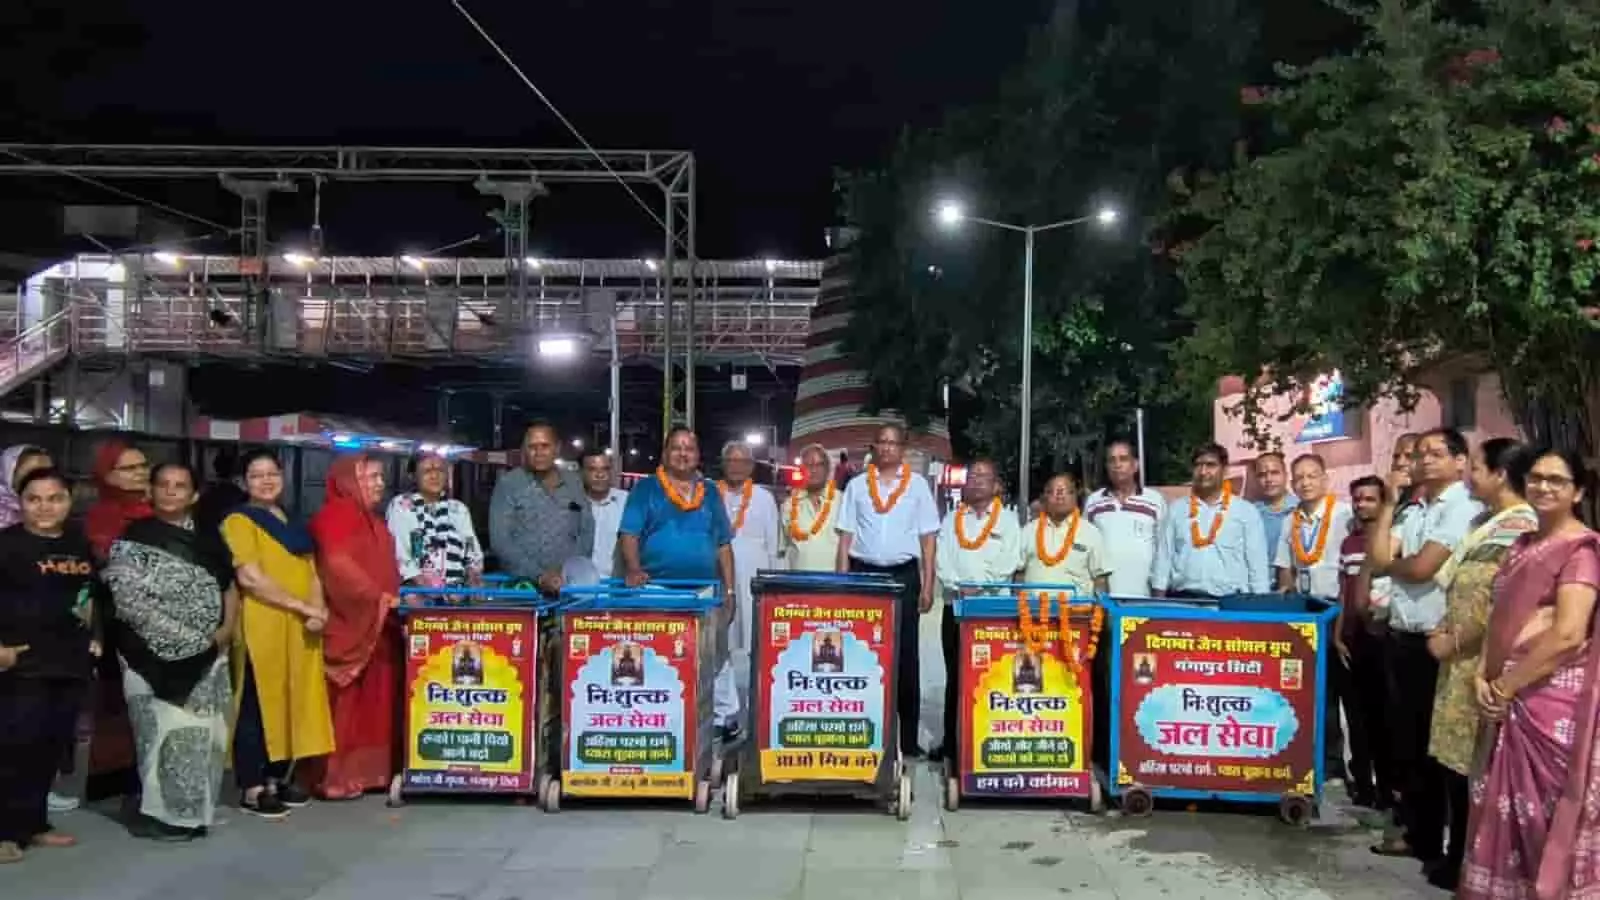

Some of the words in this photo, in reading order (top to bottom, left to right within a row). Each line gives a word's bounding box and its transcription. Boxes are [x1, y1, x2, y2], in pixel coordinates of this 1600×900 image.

[1145, 633, 1194, 650] दिगम्बर
[1198, 635, 1222, 651] जैन
[1270, 640, 1292, 657] ग्रुप
[1227, 658, 1262, 675] सिटी
[788, 699, 823, 713] जल
[828, 696, 865, 713] सेवा
[428, 710, 462, 726] जल
[465, 708, 504, 726] सेवा
[588, 713, 623, 728] जल
[628, 709, 668, 728] सेवा
[991, 719, 1024, 733] जल
[1028, 716, 1065, 733] सेवा
[1156, 720, 1211, 747] जल
[1215, 714, 1278, 749] सेवा
[776, 752, 813, 768] आओ
[820, 752, 849, 768] मित्र
[977, 776, 999, 789] हम
[1029, 773, 1080, 789] वर्धमान
